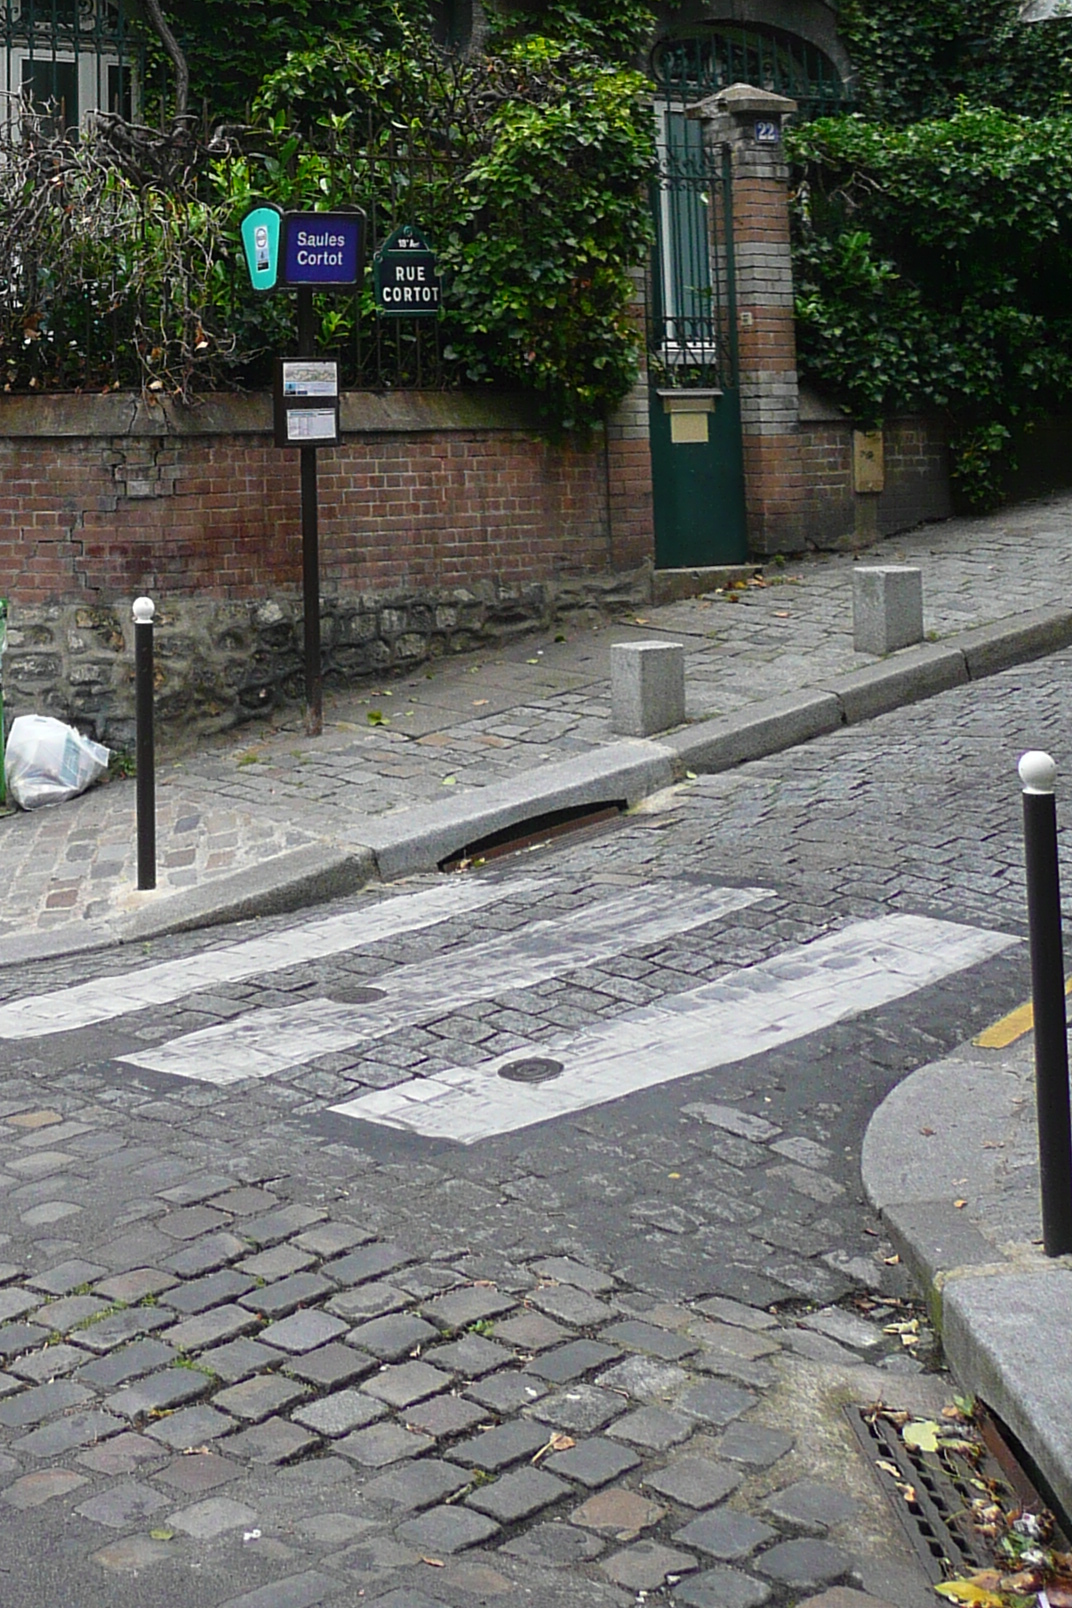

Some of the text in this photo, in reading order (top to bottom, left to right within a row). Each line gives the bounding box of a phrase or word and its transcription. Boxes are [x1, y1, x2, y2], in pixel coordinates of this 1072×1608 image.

[758, 122, 775, 140] 22
[297, 232, 346, 248] Saules
[297, 251, 343, 266] Cortot
[395, 266, 426, 281] RUE
[382, 287, 439, 302] CORTOT
